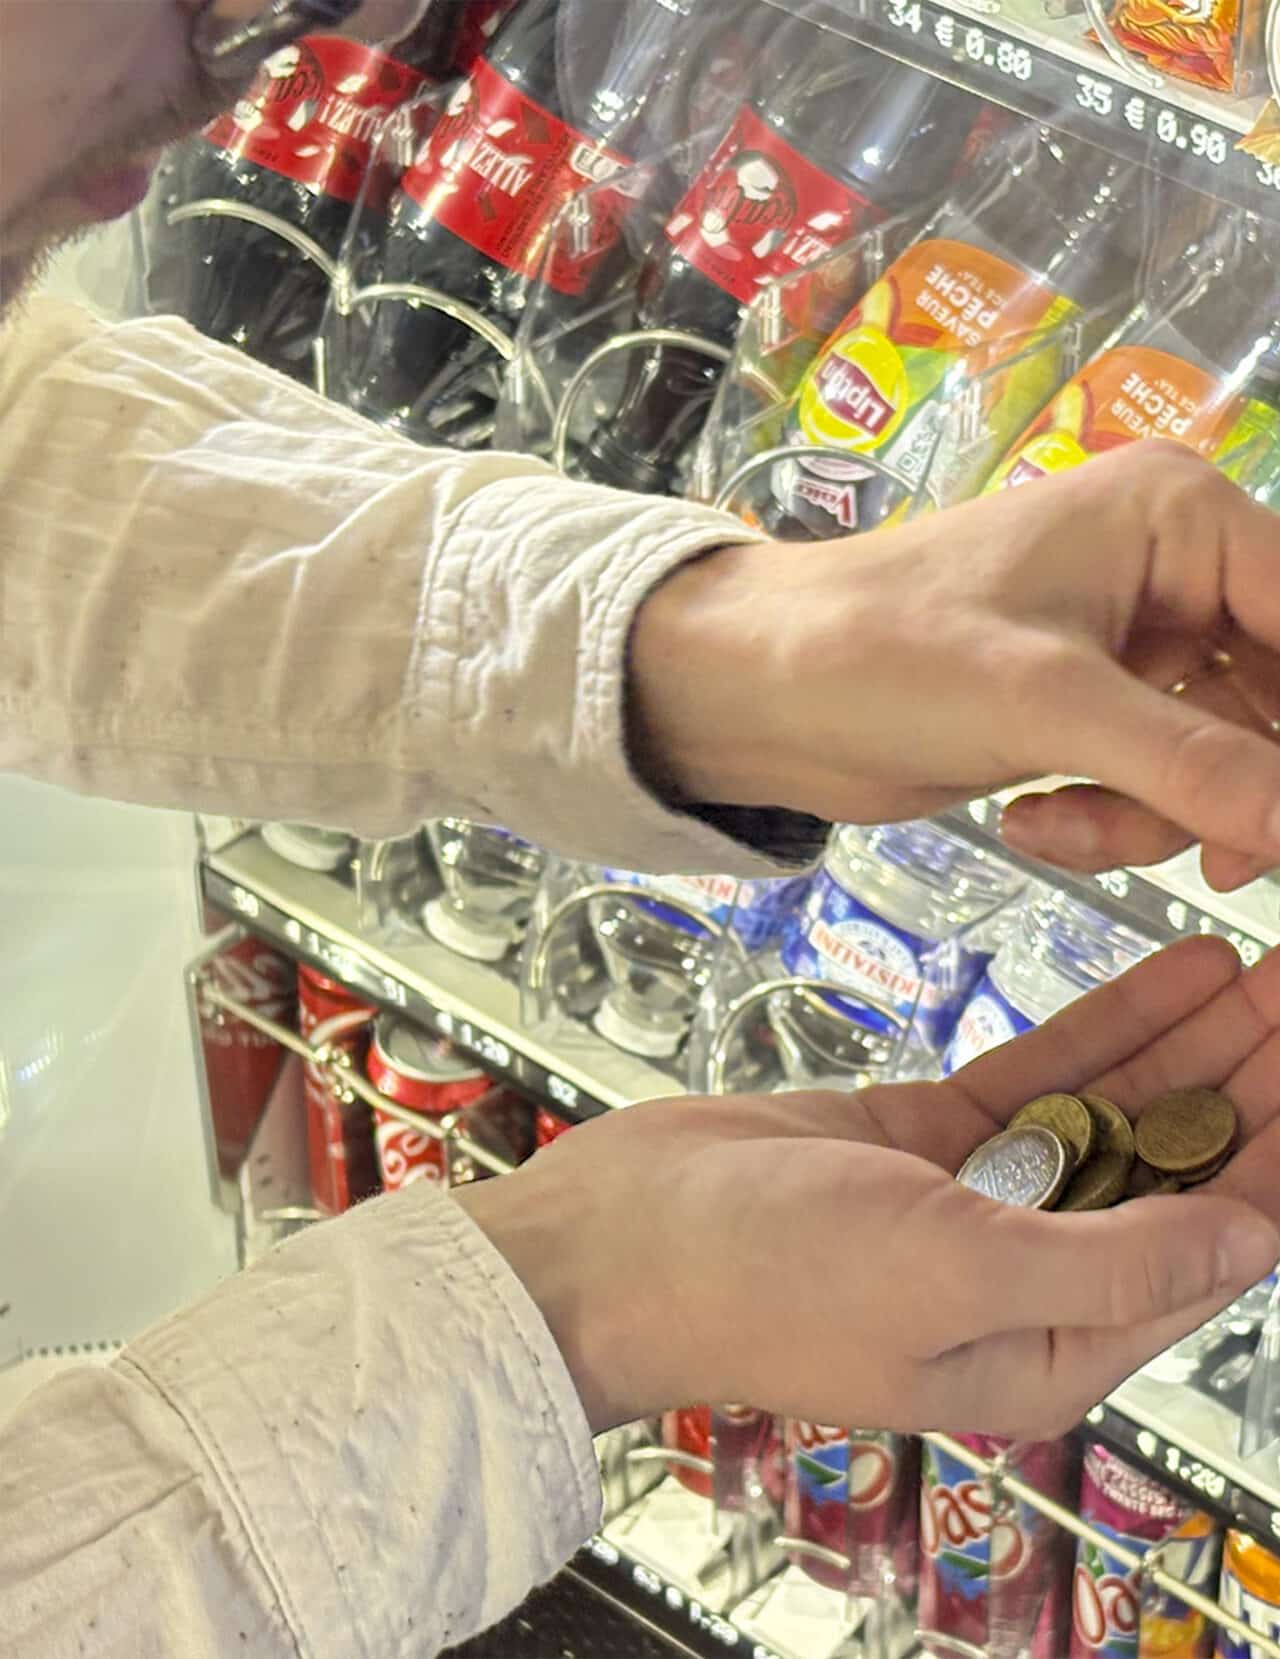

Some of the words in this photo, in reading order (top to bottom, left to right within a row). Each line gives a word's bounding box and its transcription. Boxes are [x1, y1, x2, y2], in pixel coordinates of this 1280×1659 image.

[887, 0, 922, 33] 34
[935, 16, 954, 48] €
[964, 28, 1032, 80] 0.80
[1076, 73, 1112, 115] 35
[1124, 96, 1145, 131] €
[1157, 110, 1226, 164] 0.90
[916, 290, 981, 347] SAVEUR
[925, 264, 999, 330] PÊCHE
[1121, 372, 1193, 436] PÊCHE
[1165, 1447, 1226, 1498] 1.20
